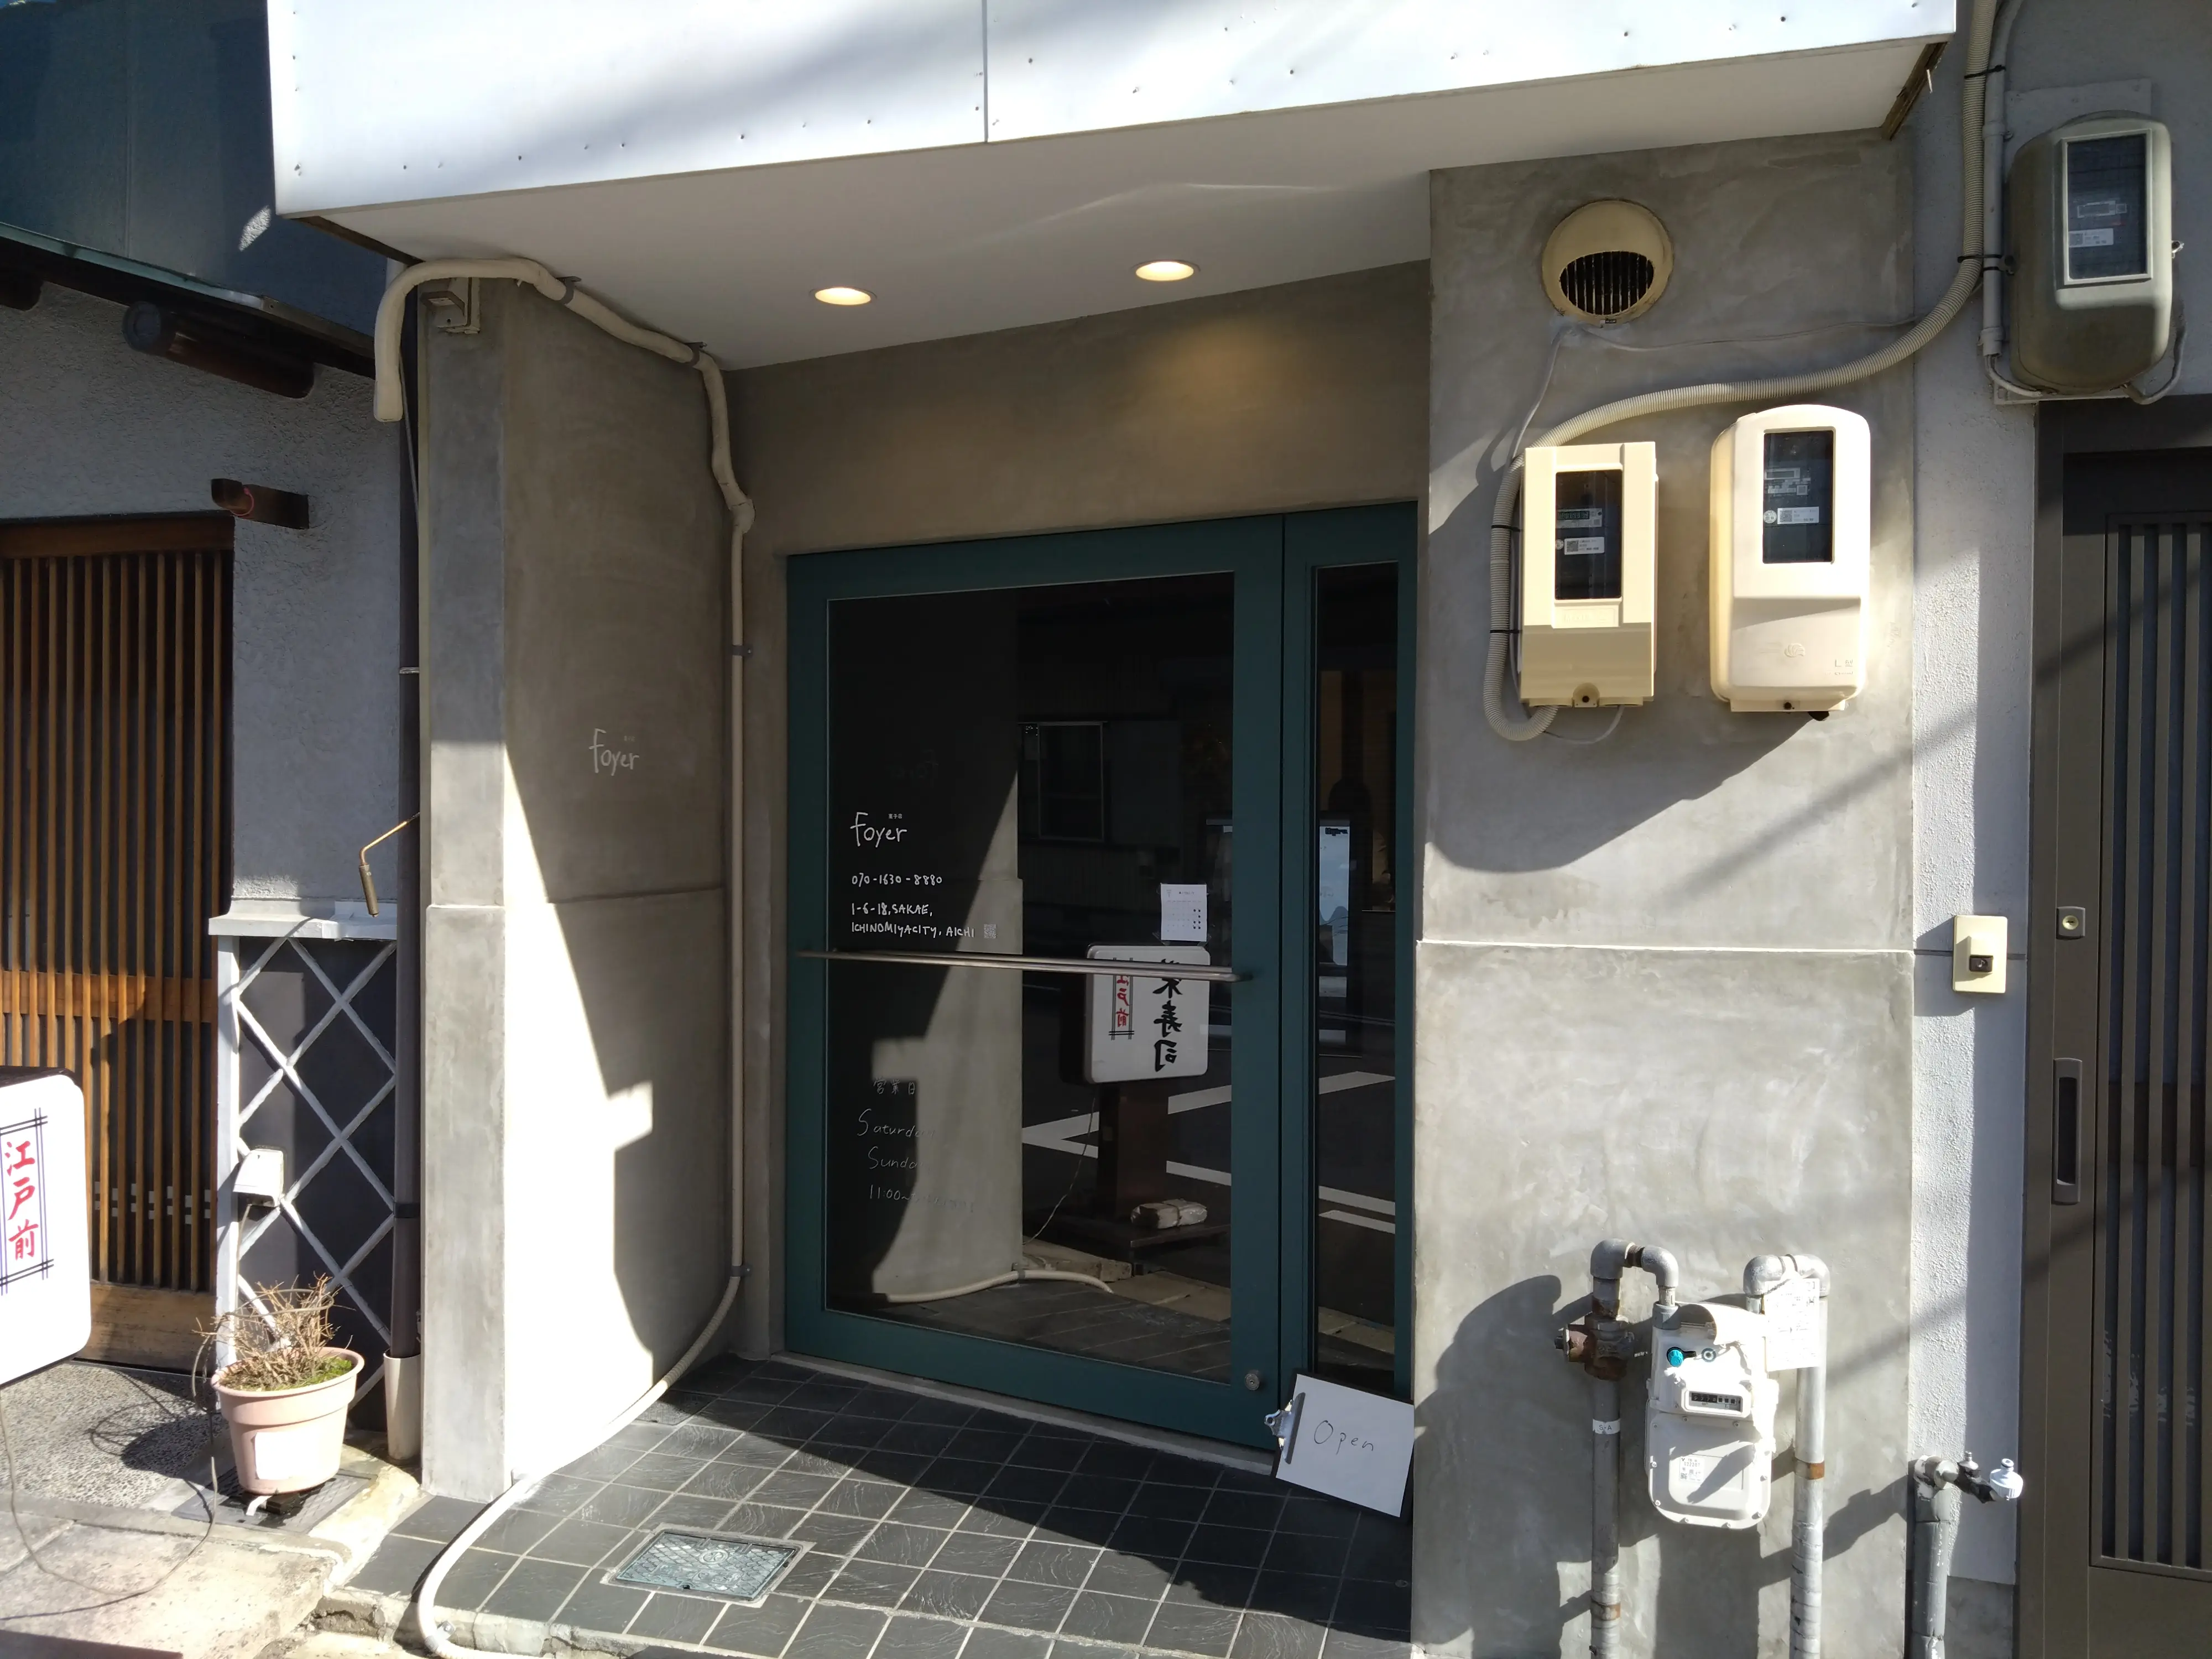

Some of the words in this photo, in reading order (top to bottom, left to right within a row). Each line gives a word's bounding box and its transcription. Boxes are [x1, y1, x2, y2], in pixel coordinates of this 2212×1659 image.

[589, 728, 640, 776] Foyer
[850, 812, 907, 847] Foyer
[852, 873, 942, 887] 070-1630-8880
[946, 926, 975, 938] AICHI
[4, 1140, 39, 1261] 江戸前
[1314, 1420, 1374, 1455] Open
